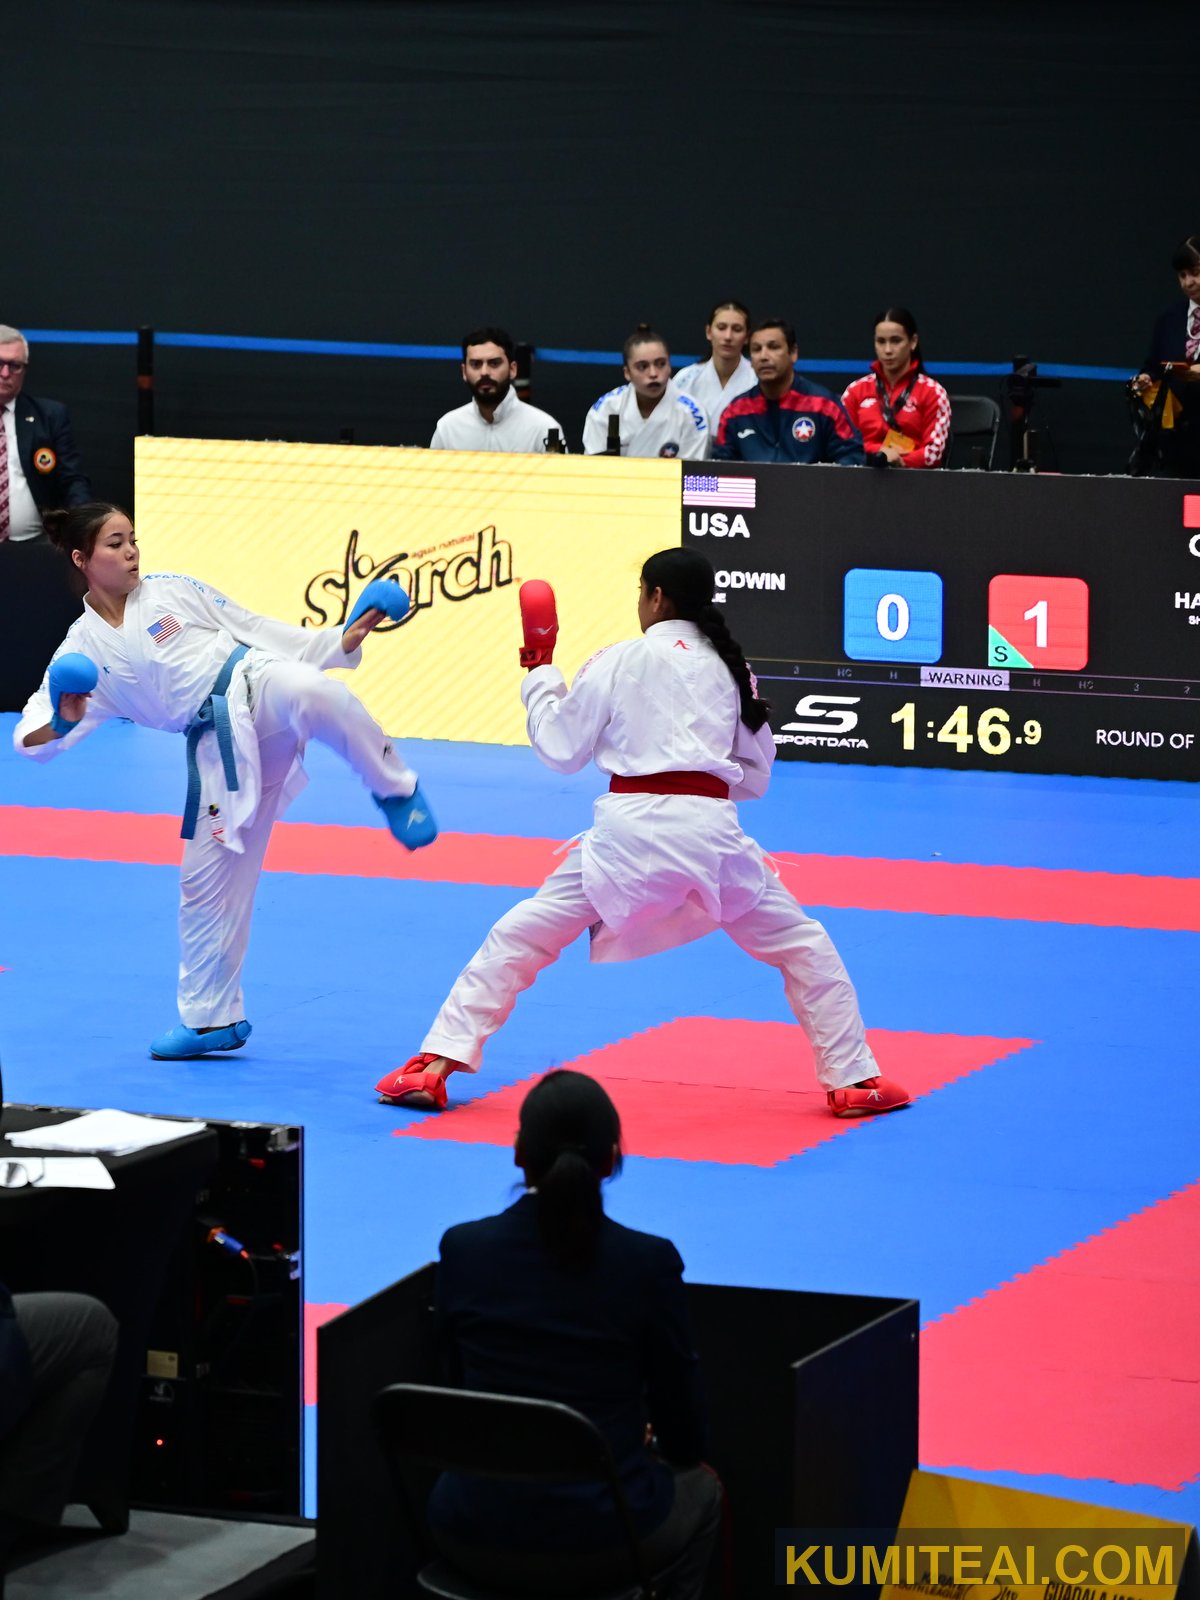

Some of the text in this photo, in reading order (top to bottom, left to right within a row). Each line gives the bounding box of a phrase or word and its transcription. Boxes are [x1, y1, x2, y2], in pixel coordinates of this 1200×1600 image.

[689, 512, 751, 539] USA
[714, 570, 786, 591] ODWIN
[876, 593, 910, 641] 0
[1023, 600, 1048, 648] 1
[994, 646, 1009, 663] S
[928, 671, 1003, 687] WARNING
[772, 733, 870, 750] SPORTDATA
[1096, 729, 1195, 749] ROUND OF
